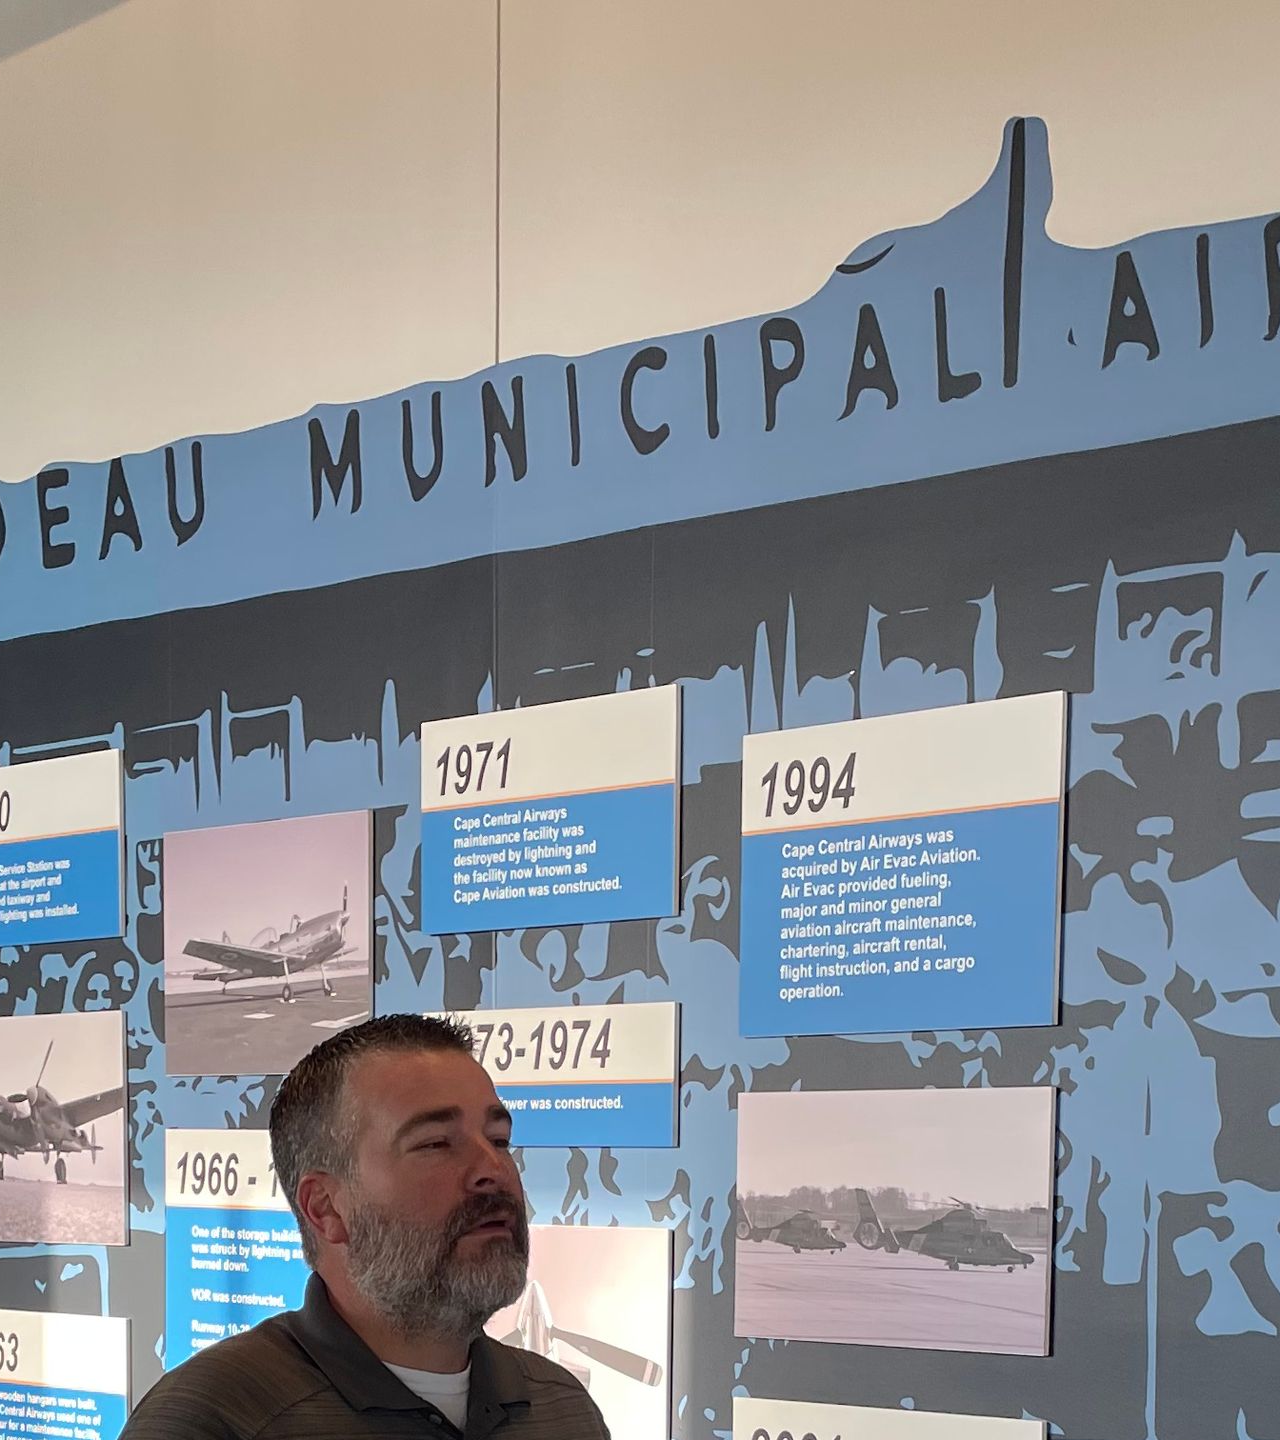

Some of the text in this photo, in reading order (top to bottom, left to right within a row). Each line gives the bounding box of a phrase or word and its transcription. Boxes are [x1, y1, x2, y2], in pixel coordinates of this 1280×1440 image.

[308, 287, 982, 519] MUNICIPAL
[436, 737, 511, 797] 1971
[761, 752, 857, 818] 1994
[452, 806, 568, 832] Cape Central Airways
[452, 824, 585, 849] maintenance facility was
[781, 829, 954, 861] Cape Central Airways was
[452, 838, 597, 868] destroyed by lightning and
[780, 846, 981, 881] acquired by Air Evac Aviation.
[452, 861, 588, 886] the facility now known as
[780, 870, 951, 899] Air Evac provided fueling,
[452, 874, 623, 905] Cape Aviation was constructed.
[780, 890, 942, 922] major and minor general
[779, 912, 976, 940] aviation aircraft maintenance,
[779, 933, 947, 960] chartering, aircraft rental,
[778, 955, 975, 983] flight instruction, and a cargo
[778, 982, 844, 1002] operation.
[476, 1018, 611, 1071] 73-1974
[529, 1098, 552, 1110] was
[553, 1094, 624, 1110] constructed.
[177, 1151, 239, 1197] 1966
